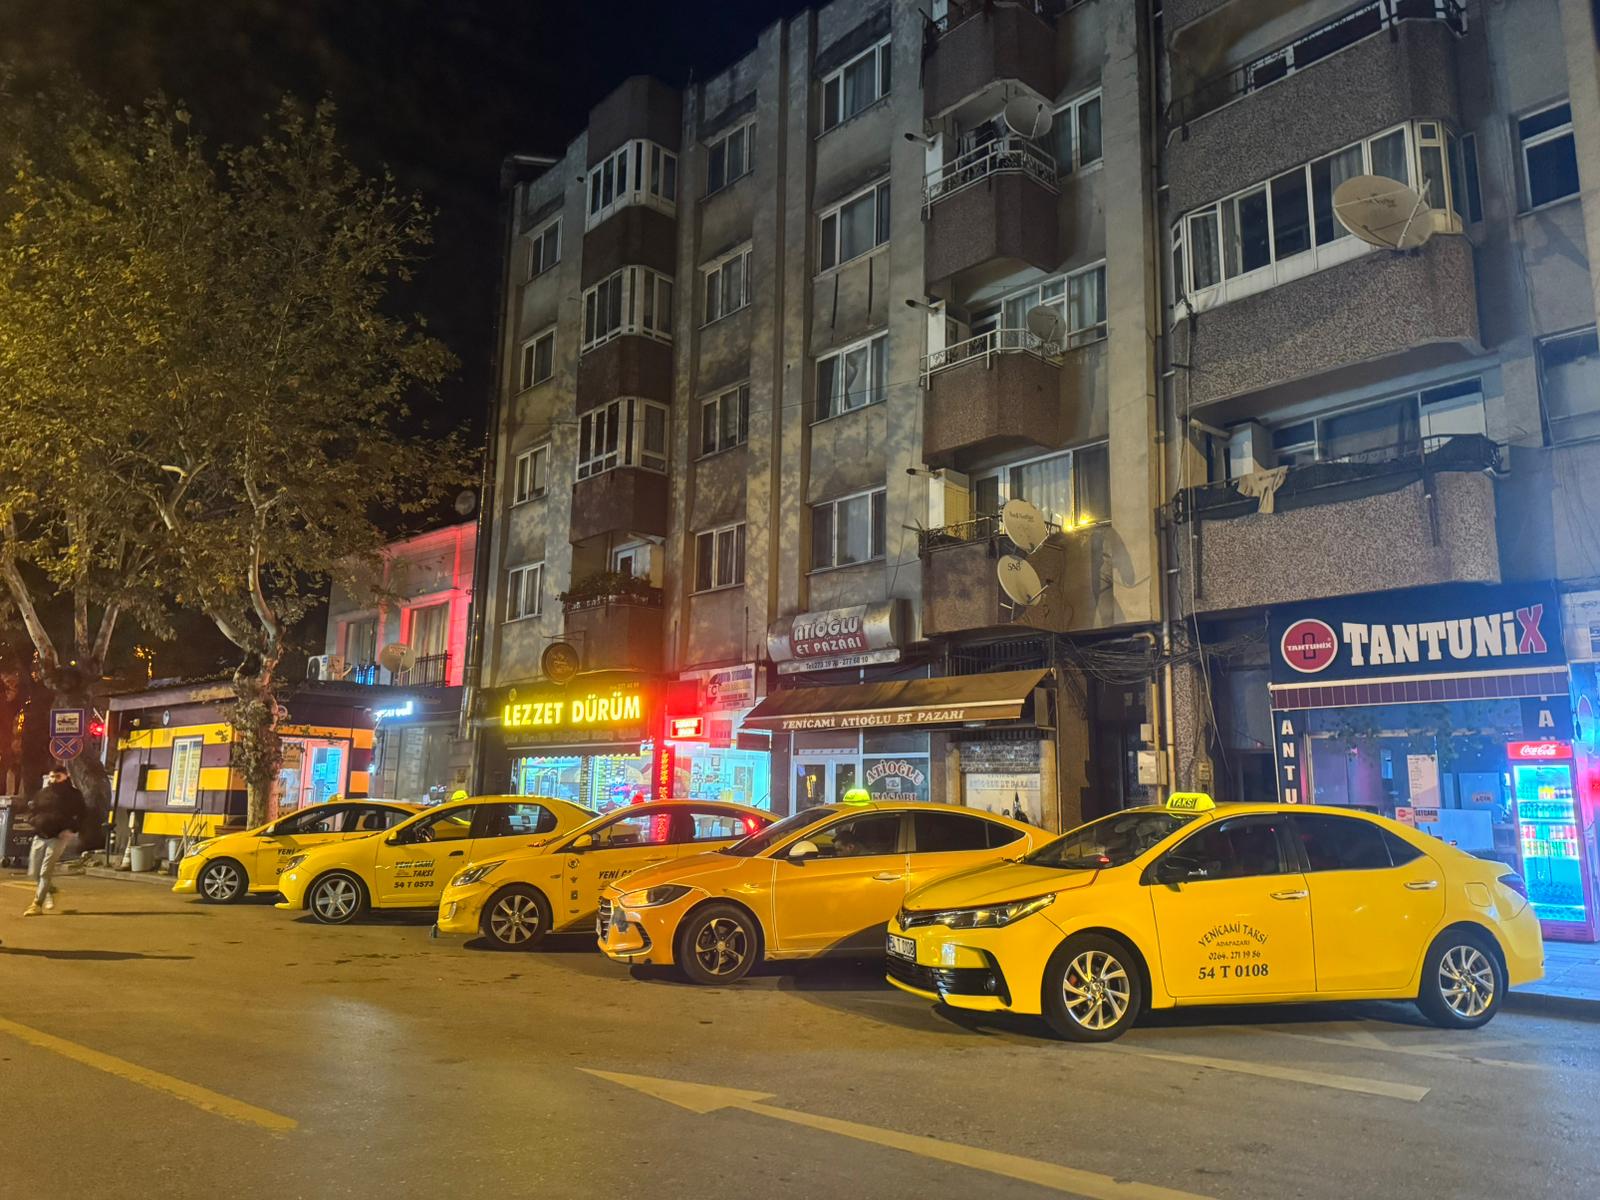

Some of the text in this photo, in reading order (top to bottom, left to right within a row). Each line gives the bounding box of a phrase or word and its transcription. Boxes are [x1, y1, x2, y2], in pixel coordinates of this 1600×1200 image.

[796, 636, 862, 655] ET PAZARI
[504, 691, 640, 727] LEZZET DÜRÜM
[897, 713, 912, 723] ET
[916, 710, 965, 722] PAZARI
[1198, 963, 1269, 980] 54 T 0108
